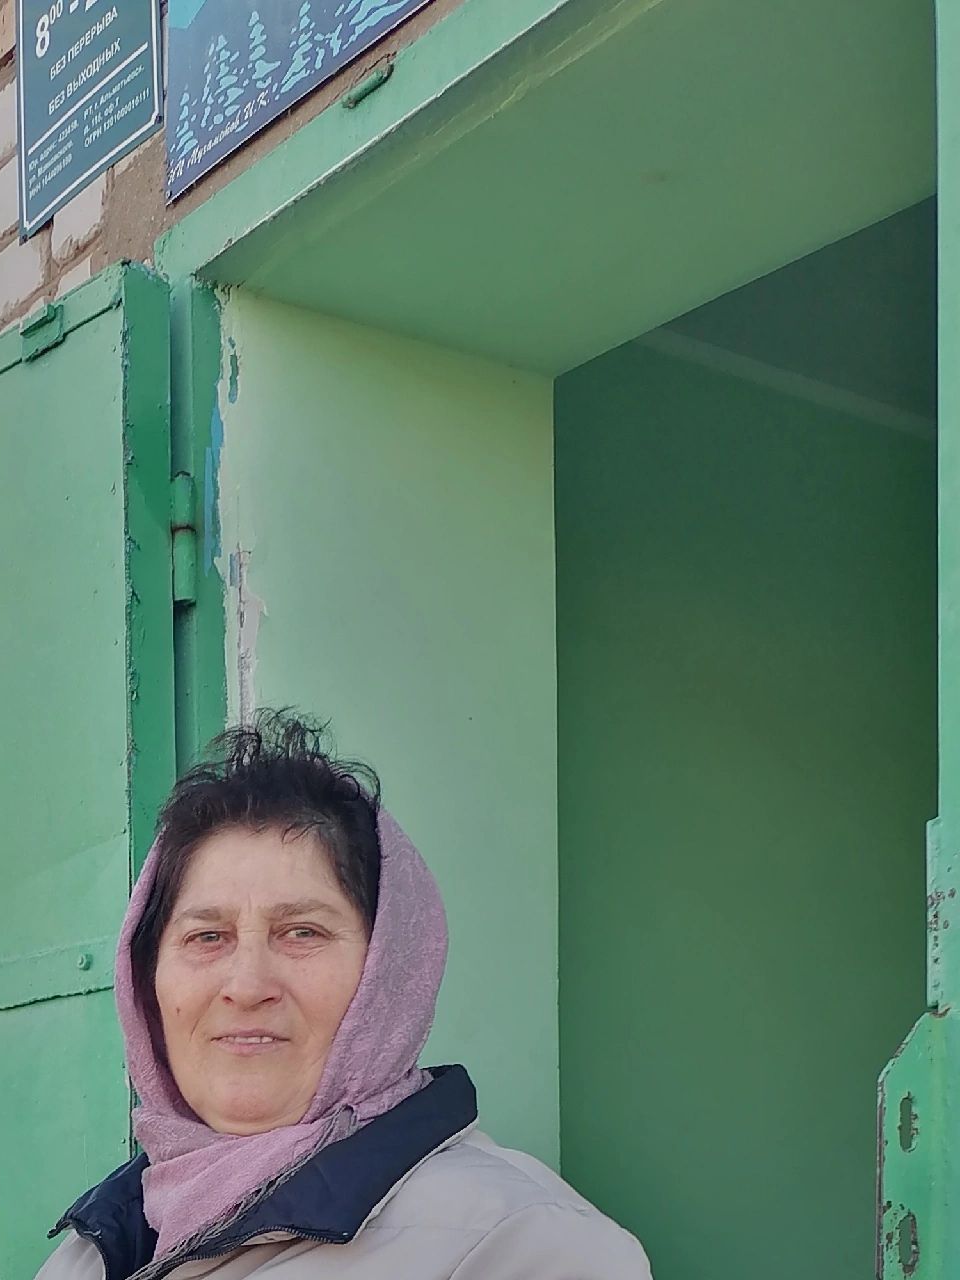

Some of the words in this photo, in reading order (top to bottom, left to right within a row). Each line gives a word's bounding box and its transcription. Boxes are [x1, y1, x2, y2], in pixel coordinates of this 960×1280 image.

[48, 89, 66, 115] БЕЗ
[66, 37, 121, 98] ВЫХОДНЫХ
[50, 55, 66, 80] БЕЗ
[67, 5, 118, 62] ПЕРЕРЫВА
